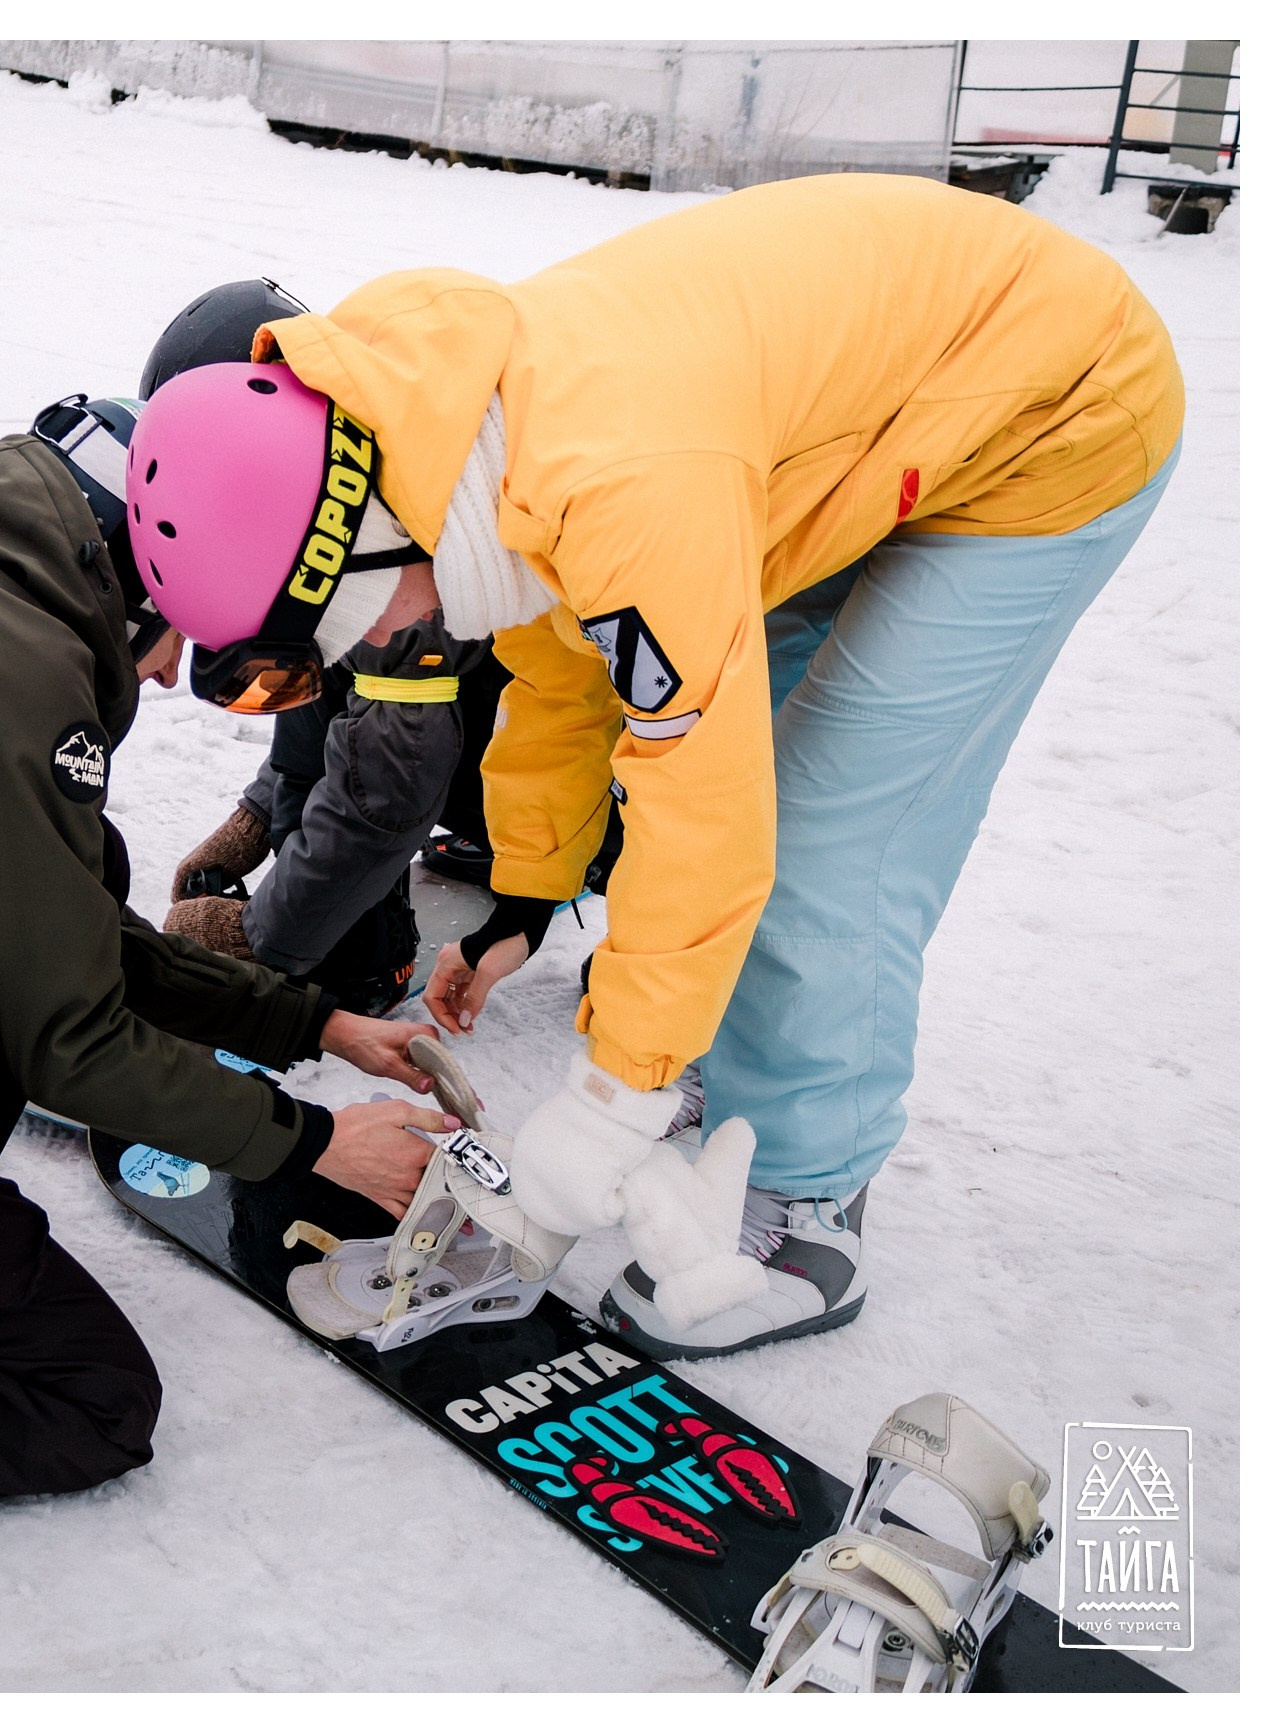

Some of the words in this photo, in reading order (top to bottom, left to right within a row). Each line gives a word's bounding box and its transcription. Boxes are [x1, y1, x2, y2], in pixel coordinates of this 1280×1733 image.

[55, 752, 105, 775] MOUNTAIN
[81, 771, 105, 788] MAN
[497, 1374, 703, 1499] SCOTT
